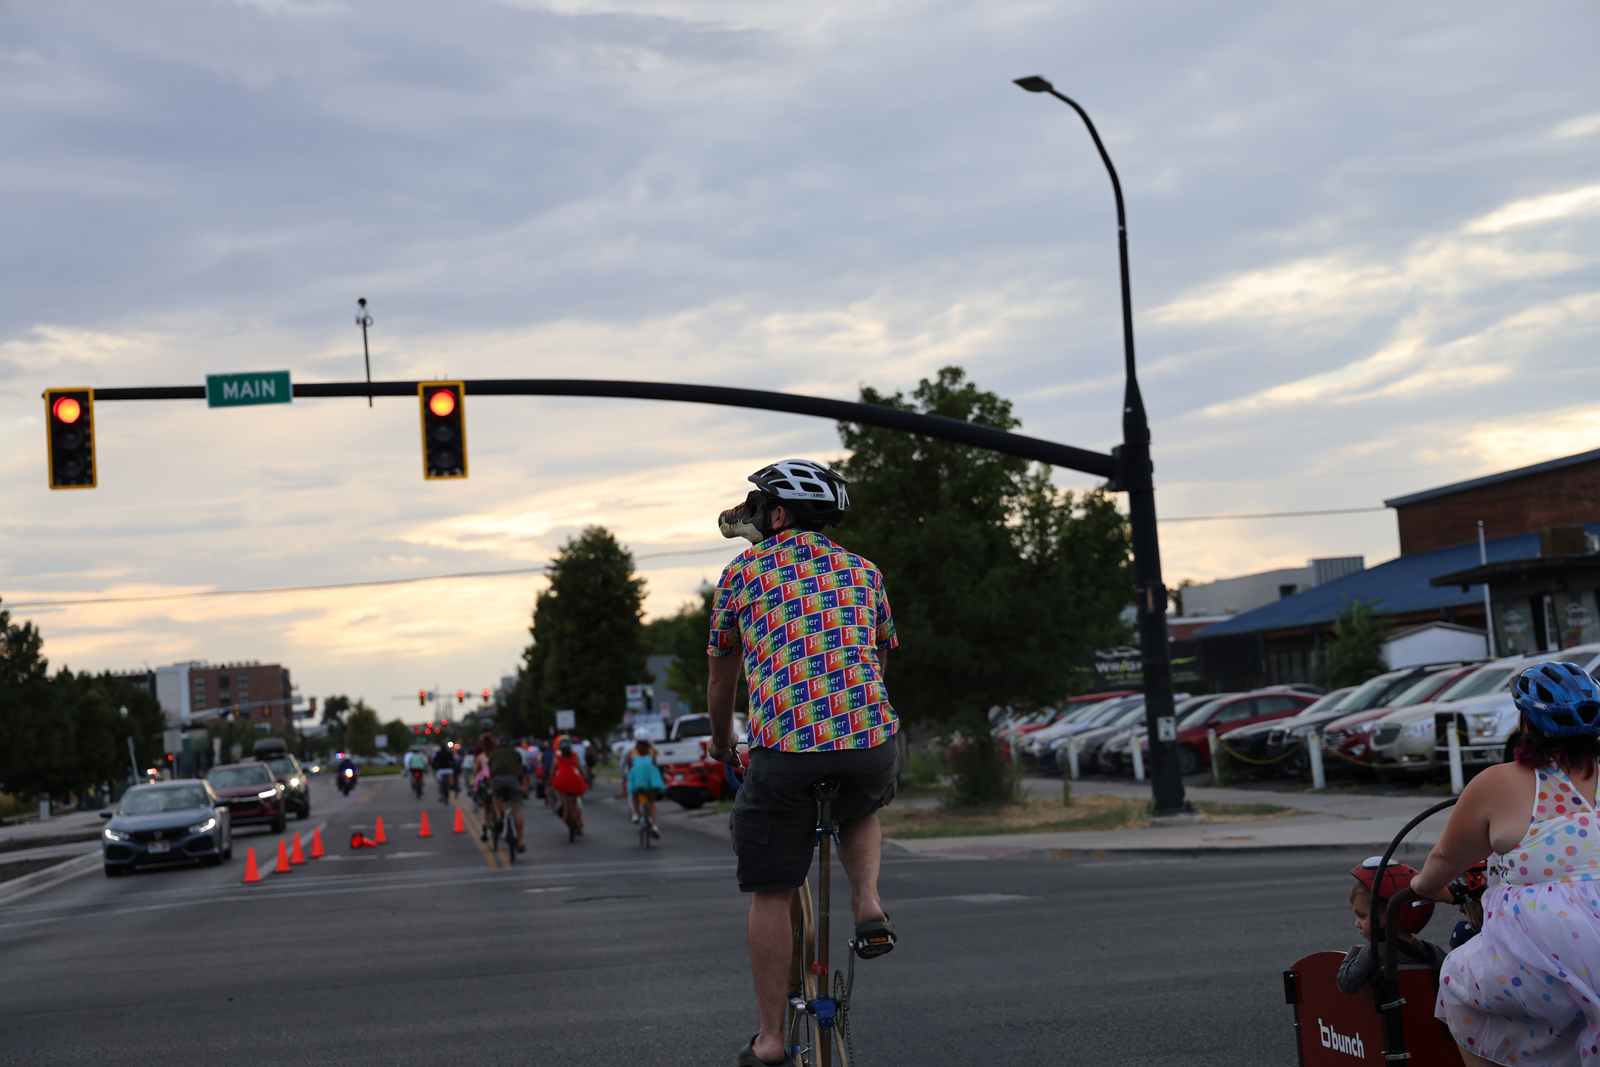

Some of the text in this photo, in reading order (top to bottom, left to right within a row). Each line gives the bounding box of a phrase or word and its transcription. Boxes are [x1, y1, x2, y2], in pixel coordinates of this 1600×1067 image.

[223, 378, 276, 400] MAIN
[779, 547, 807, 562] Fisher
[833, 553, 858, 565] Fisher
[744, 559, 771, 577] Fisher
[799, 562, 826, 574] Fisher
[764, 570, 792, 585] Fisher
[821, 573, 848, 586] Fisher
[786, 581, 813, 595] Fisher
[841, 588, 864, 600] Fisher
[805, 595, 833, 608] Fisher
[770, 604, 798, 624] Fisher
[826, 609, 852, 623] Fisher
[790, 618, 818, 634] Fisher
[844, 627, 866, 639] Fisher
[809, 634, 837, 649] Fisher
[775, 644, 801, 665] Fisher
[829, 650, 856, 665] Fisher
[793, 660, 821, 676] Fisher
[848, 665, 871, 680] Fisher
[762, 674, 785, 696] Fisher
[812, 676, 840, 692] Fisher
[777, 687, 804, 707] Fisher
[833, 692, 861, 708] Fisher
[797, 703, 826, 720] Fisher
[854, 709, 878, 725] Fisher
[765, 717, 790, 739] Fisher
[818, 721, 846, 736] Fisher
[783, 733, 810, 752] Fisher
[839, 737, 865, 750] Fisher
[1330, 1024, 1365, 1059] bunch
